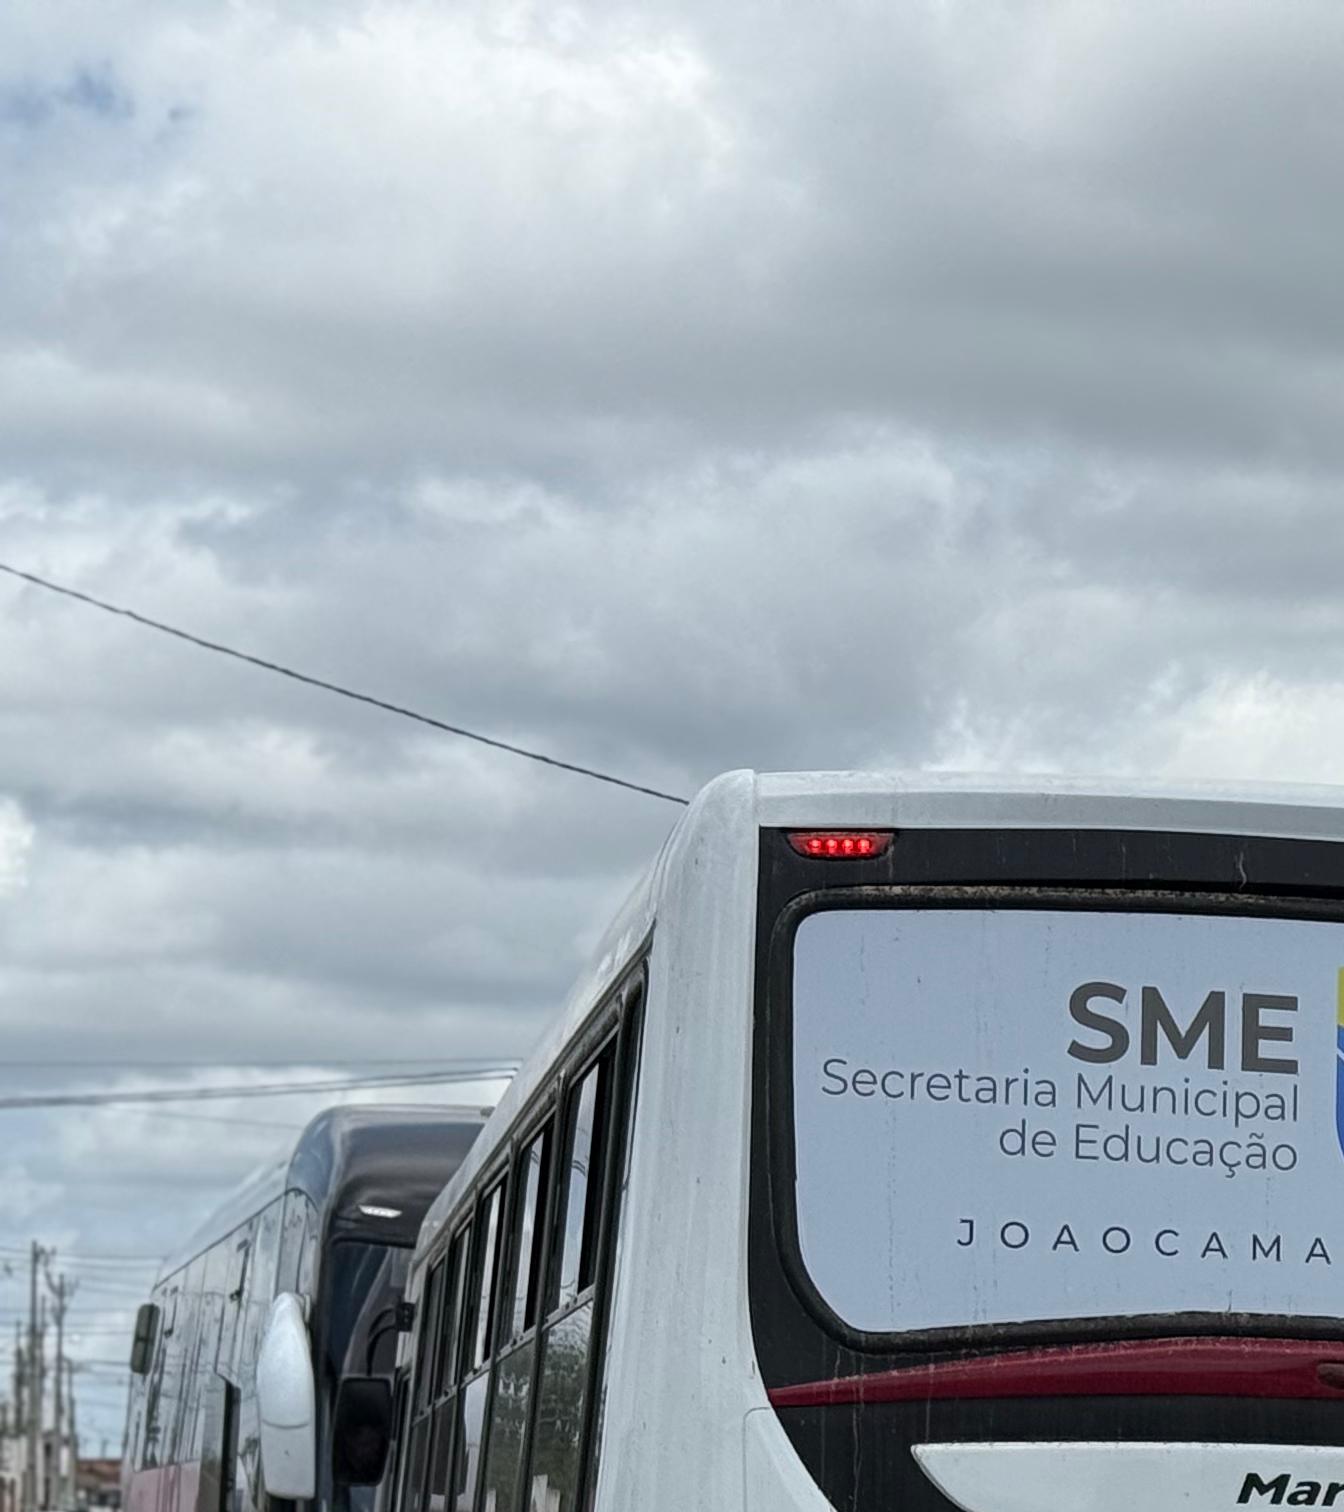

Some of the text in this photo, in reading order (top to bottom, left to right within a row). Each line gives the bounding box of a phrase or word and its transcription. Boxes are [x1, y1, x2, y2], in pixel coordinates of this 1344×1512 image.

[1066, 981, 1299, 1076] SME
[820, 1058, 1299, 1128] Secretaria Municipal
[999, 1118, 1298, 1179] de Educação
